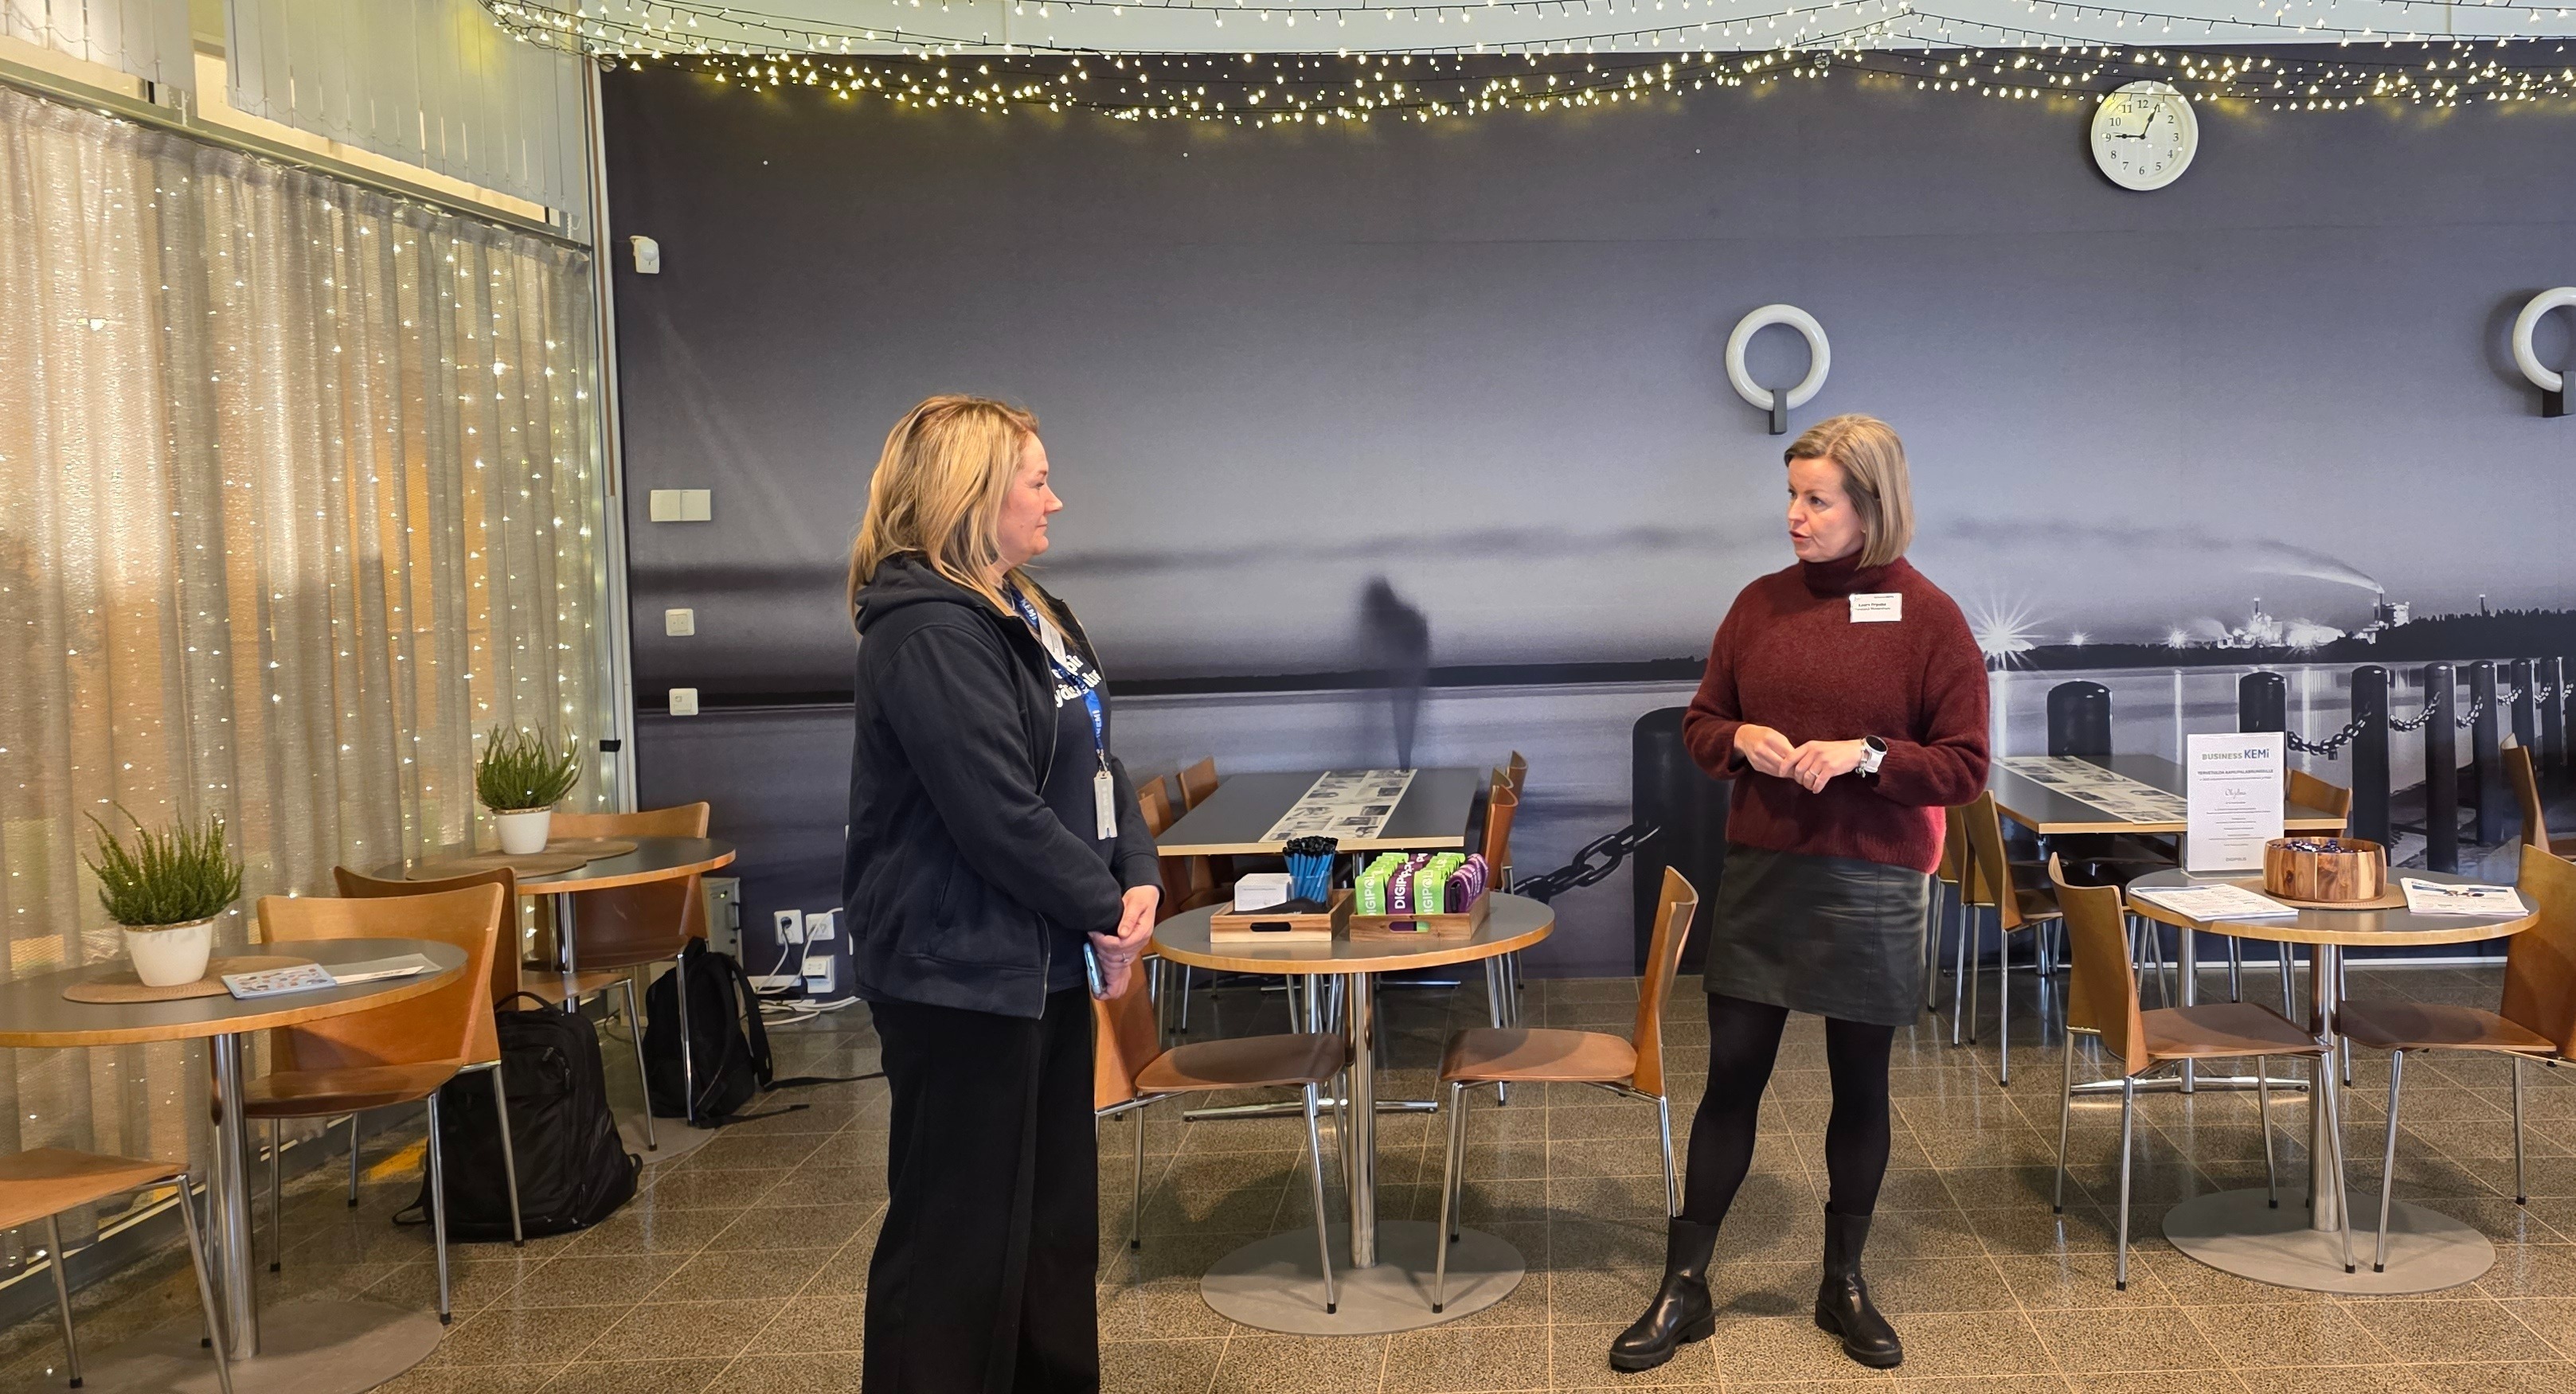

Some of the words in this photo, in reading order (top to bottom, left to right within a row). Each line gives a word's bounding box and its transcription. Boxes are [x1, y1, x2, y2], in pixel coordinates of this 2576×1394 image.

[2122, 104, 2132, 113] 11
[2137, 100, 2148, 108] 12
[2109, 117, 2121, 126] 10
[2173, 133, 2179, 142] 3
